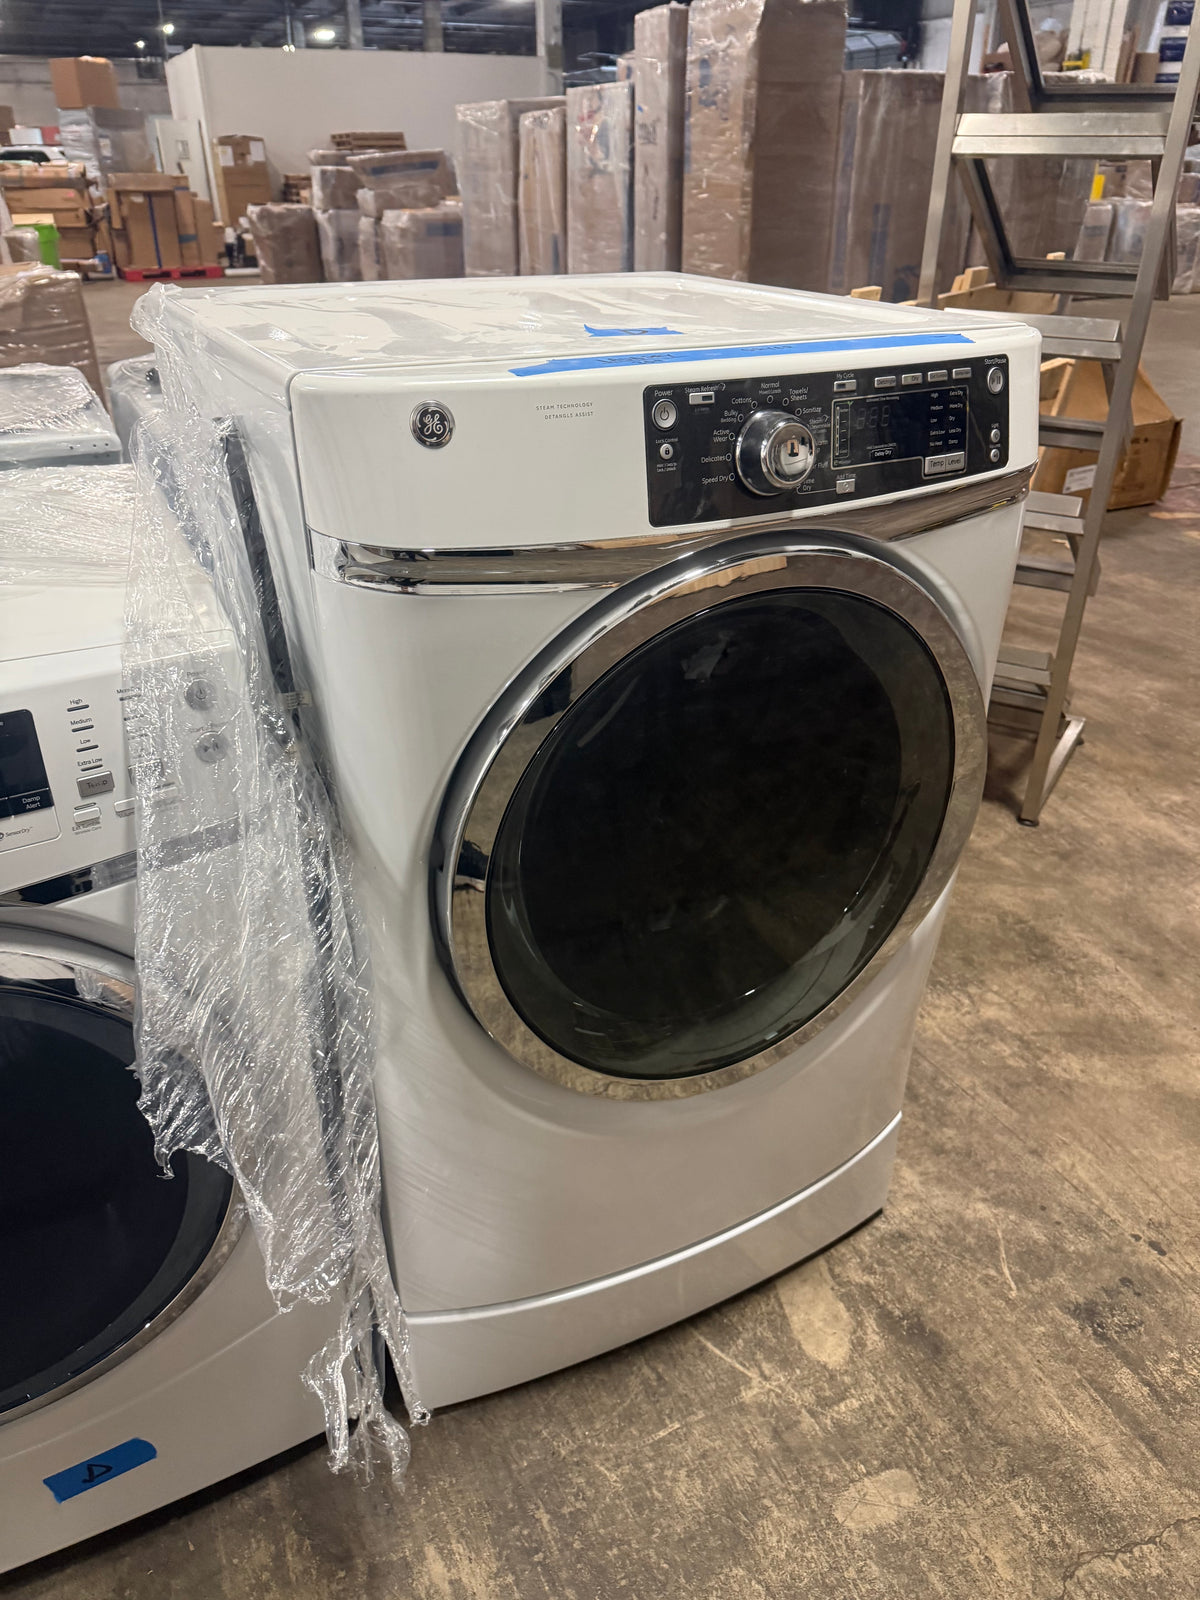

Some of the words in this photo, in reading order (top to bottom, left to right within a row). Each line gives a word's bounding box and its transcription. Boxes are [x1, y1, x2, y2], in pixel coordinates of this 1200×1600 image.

[761, 381, 780, 389] Normal
[684, 386, 700, 394] Steam
[789, 387, 809, 395] Towels/
[731, 397, 752, 405] Cottons
[556, 402, 594, 410] TECHNOLOGY
[544, 412, 574, 420] DETANGLE
[724, 410, 739, 418] Bulky
[423, 413, 444, 435] GE
[701, 456, 726, 464] Delicates
[930, 460, 945, 468] Temp
[702, 477, 718, 485] Speed
[719, 475, 729, 483] Dry
[70, 698, 83, 706] High
[70, 717, 93, 726] Medium
[77, 759, 92, 767] Extra
[22, 795, 41, 804] Damp
[26, 802, 41, 811] Alert
